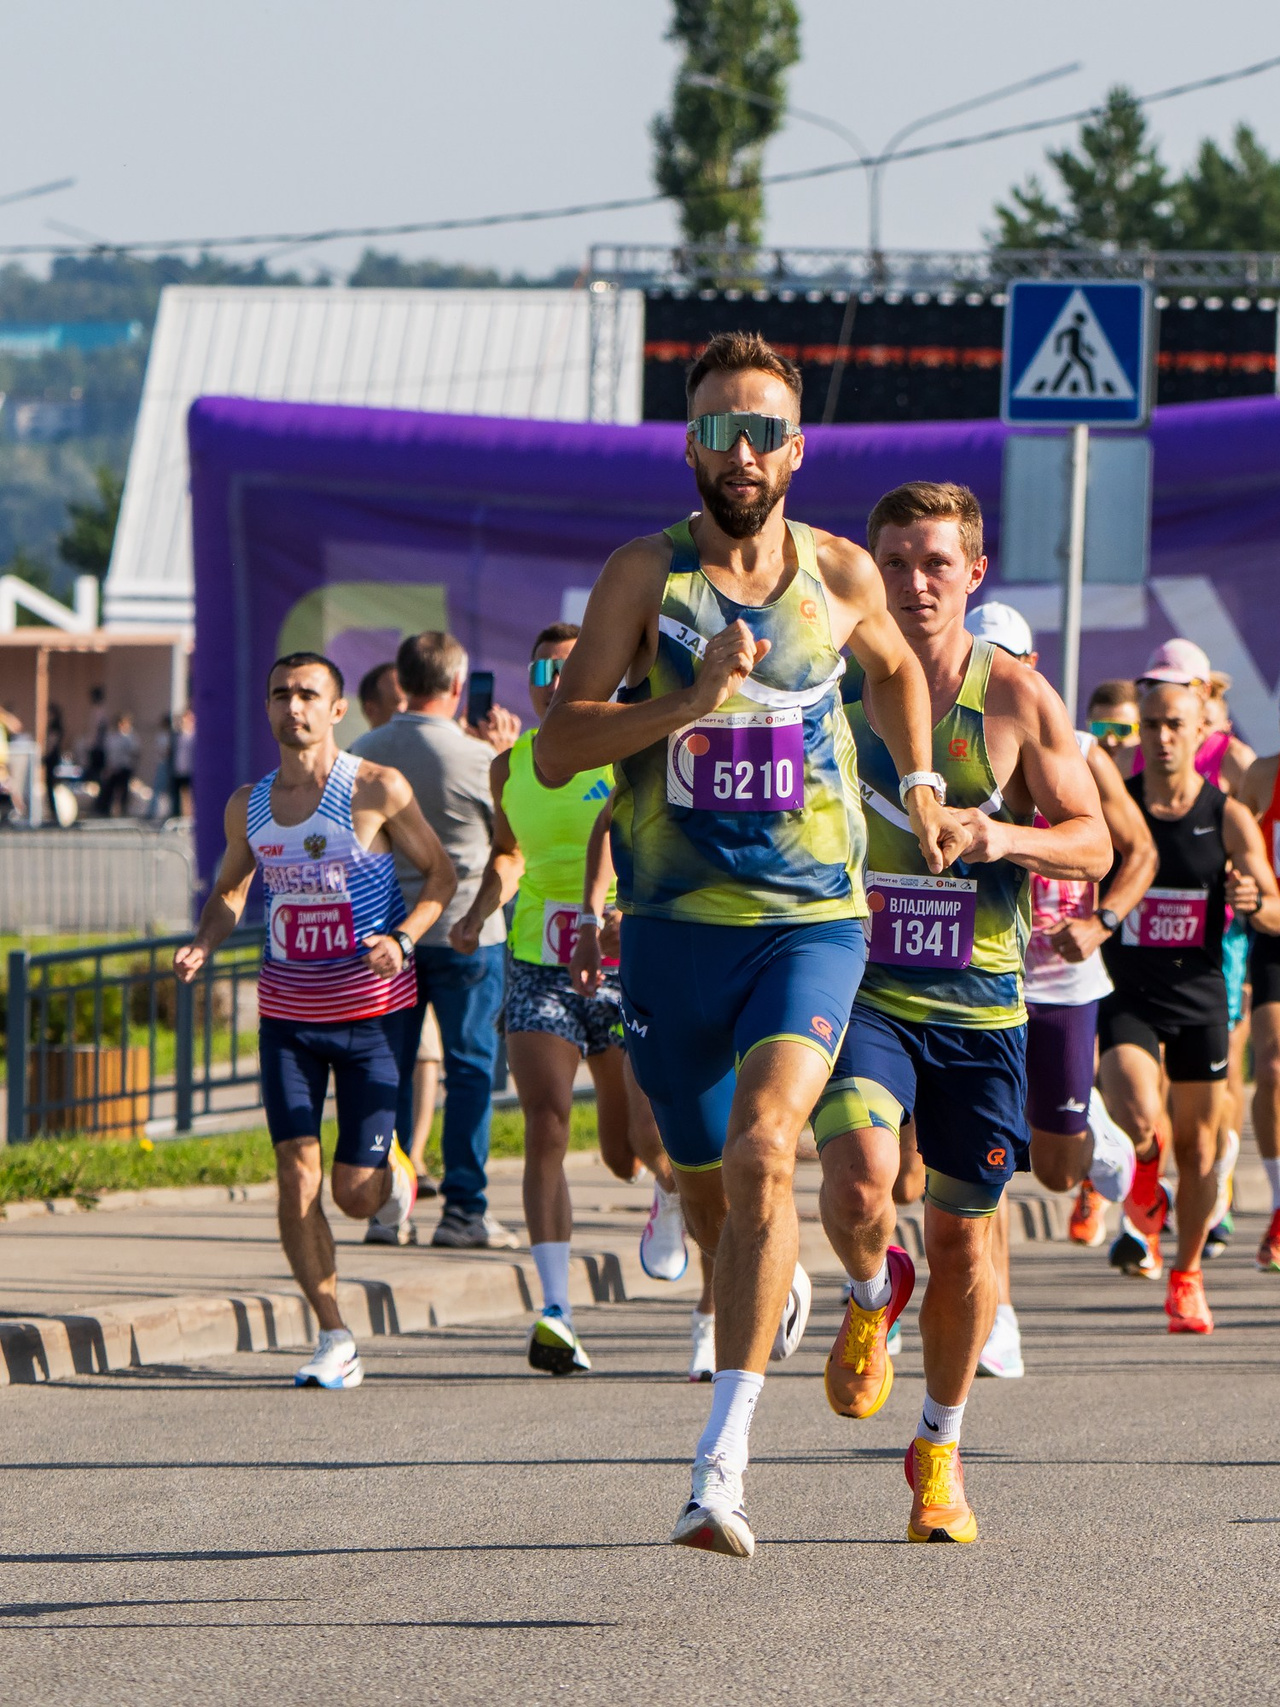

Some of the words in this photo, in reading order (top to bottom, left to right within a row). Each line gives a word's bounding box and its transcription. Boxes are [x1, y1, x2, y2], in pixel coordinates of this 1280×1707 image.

[713, 758, 793, 800] 5210
[944, 880, 957, 888] Пэй
[297, 907, 340, 925] ДМИТРИЙ
[889, 897, 962, 916] ВЛАДИМИР
[295, 924, 349, 953] 4714
[891, 918, 960, 957] 1341
[1148, 915, 1199, 941] 3037
